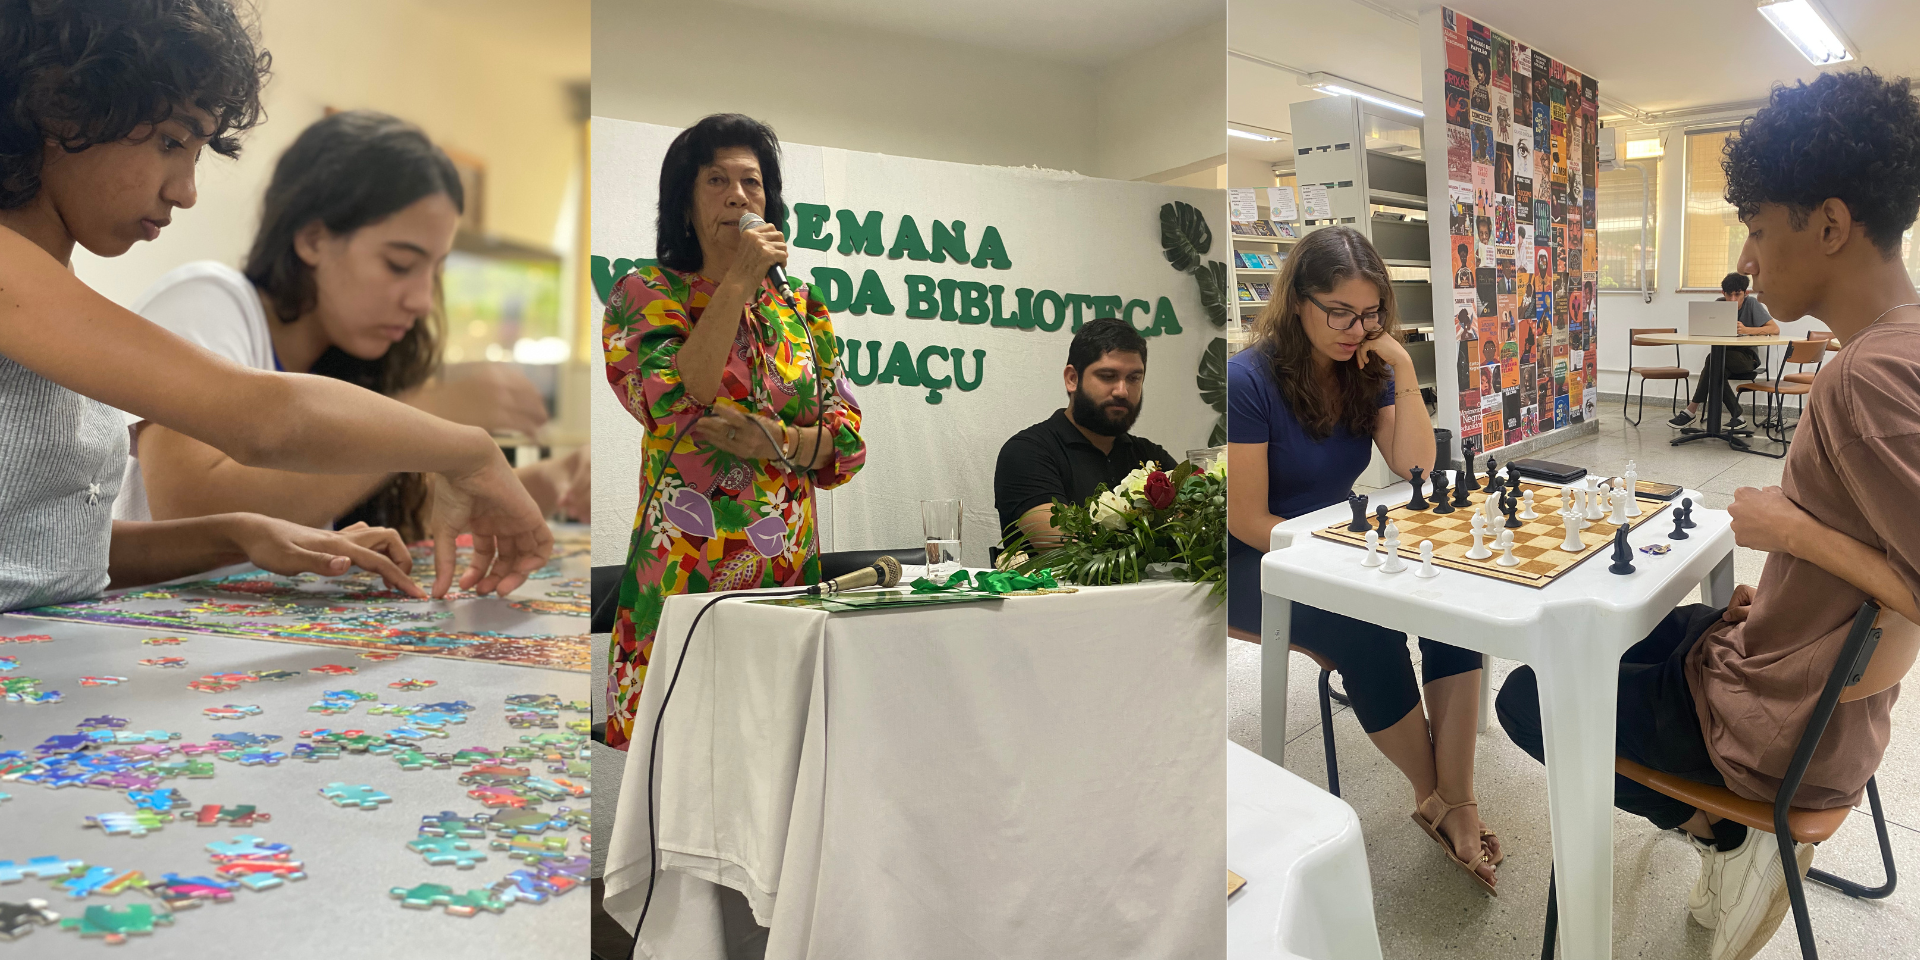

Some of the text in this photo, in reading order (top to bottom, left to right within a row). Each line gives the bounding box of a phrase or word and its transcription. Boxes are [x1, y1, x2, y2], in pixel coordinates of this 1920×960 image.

[1444, 71, 1469, 90] ORIXÁS
[811, 267, 1183, 338] DA BIBLIOTECA
